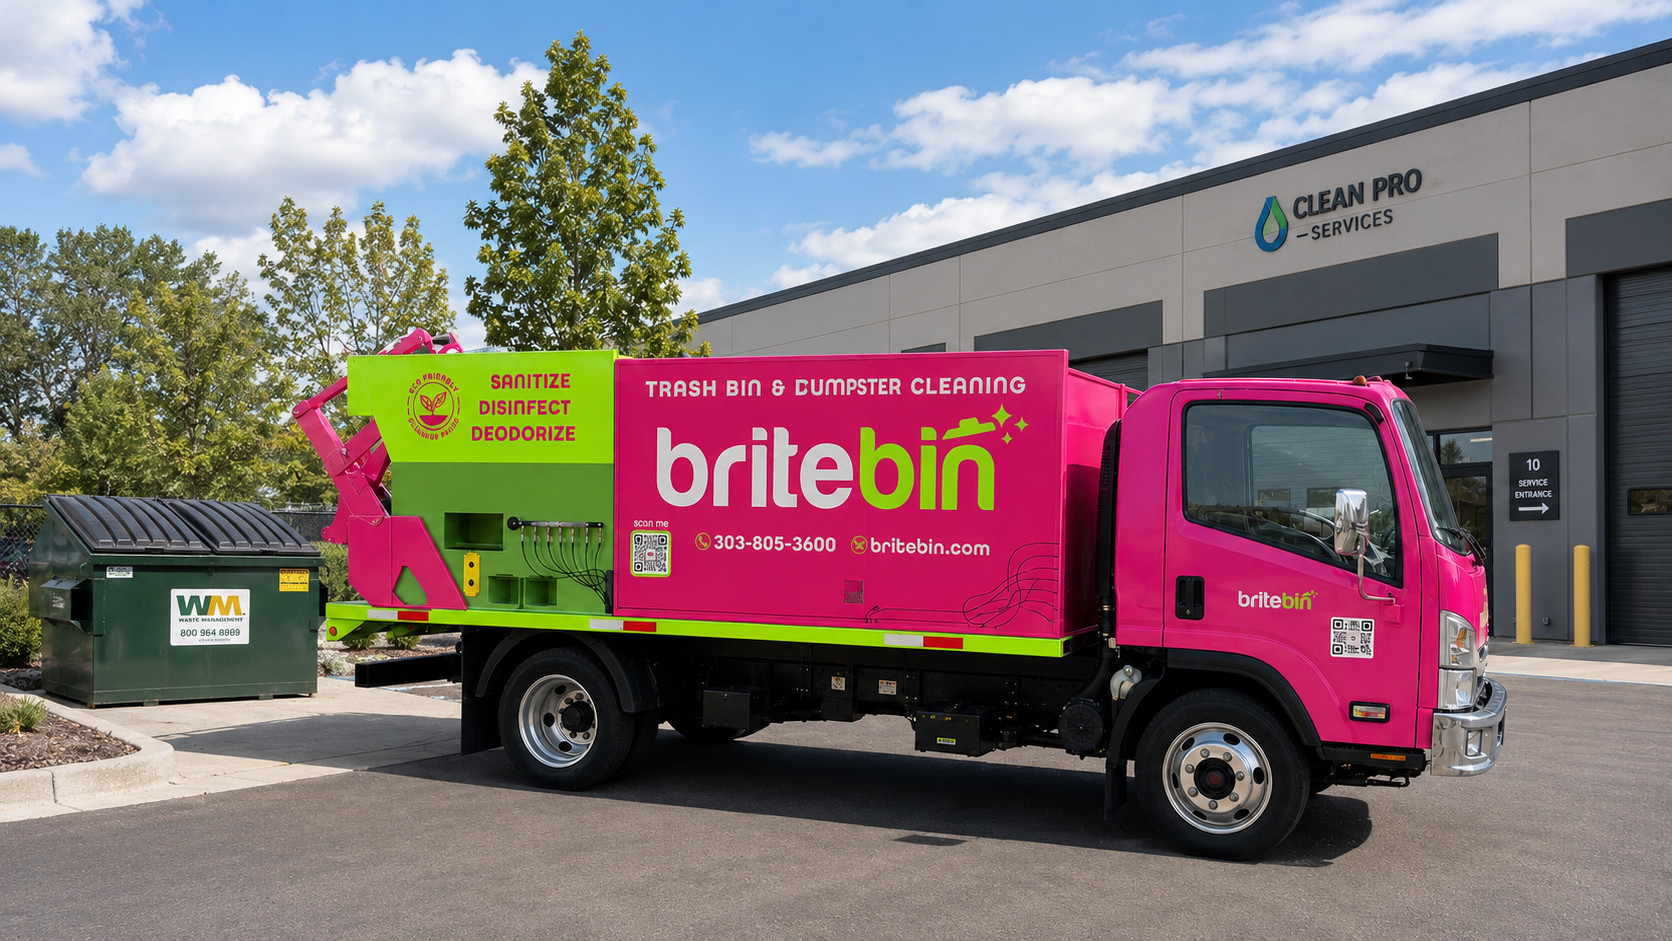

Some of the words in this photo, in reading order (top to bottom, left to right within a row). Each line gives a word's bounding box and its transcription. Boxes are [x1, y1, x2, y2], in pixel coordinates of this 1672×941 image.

[1293, 181, 1364, 219] CLEAN
[1372, 168, 1422, 201] PRO
[1311, 208, 1393, 240] SERVICES
[490, 373, 571, 390] SANITIZE
[645, 380, 717, 398] TRASH
[726, 379, 762, 397] BIN
[771, 379, 786, 397] &
[795, 377, 901, 396] DUMPSTER
[910, 376, 1026, 395] CLEANING
[479, 399, 571, 416] DISINFECT
[471, 425, 576, 442] DEODORIZE
[656, 425, 996, 511] britebin
[1526, 458, 1541, 471] 10
[1518, 478, 1549, 488] SERVICE
[1514, 490, 1553, 499] ENTRANCE
[633, 519, 654, 528] scan
[655, 519, 669, 528] me
[713, 534, 837, 553] 303-805-3600
[870, 536, 990, 556] britebin.com
[176, 595, 242, 616] WM
[1238, 590, 1312, 611] britebin
[180, 628, 198, 637] 800
[199, 628, 216, 637] 964
